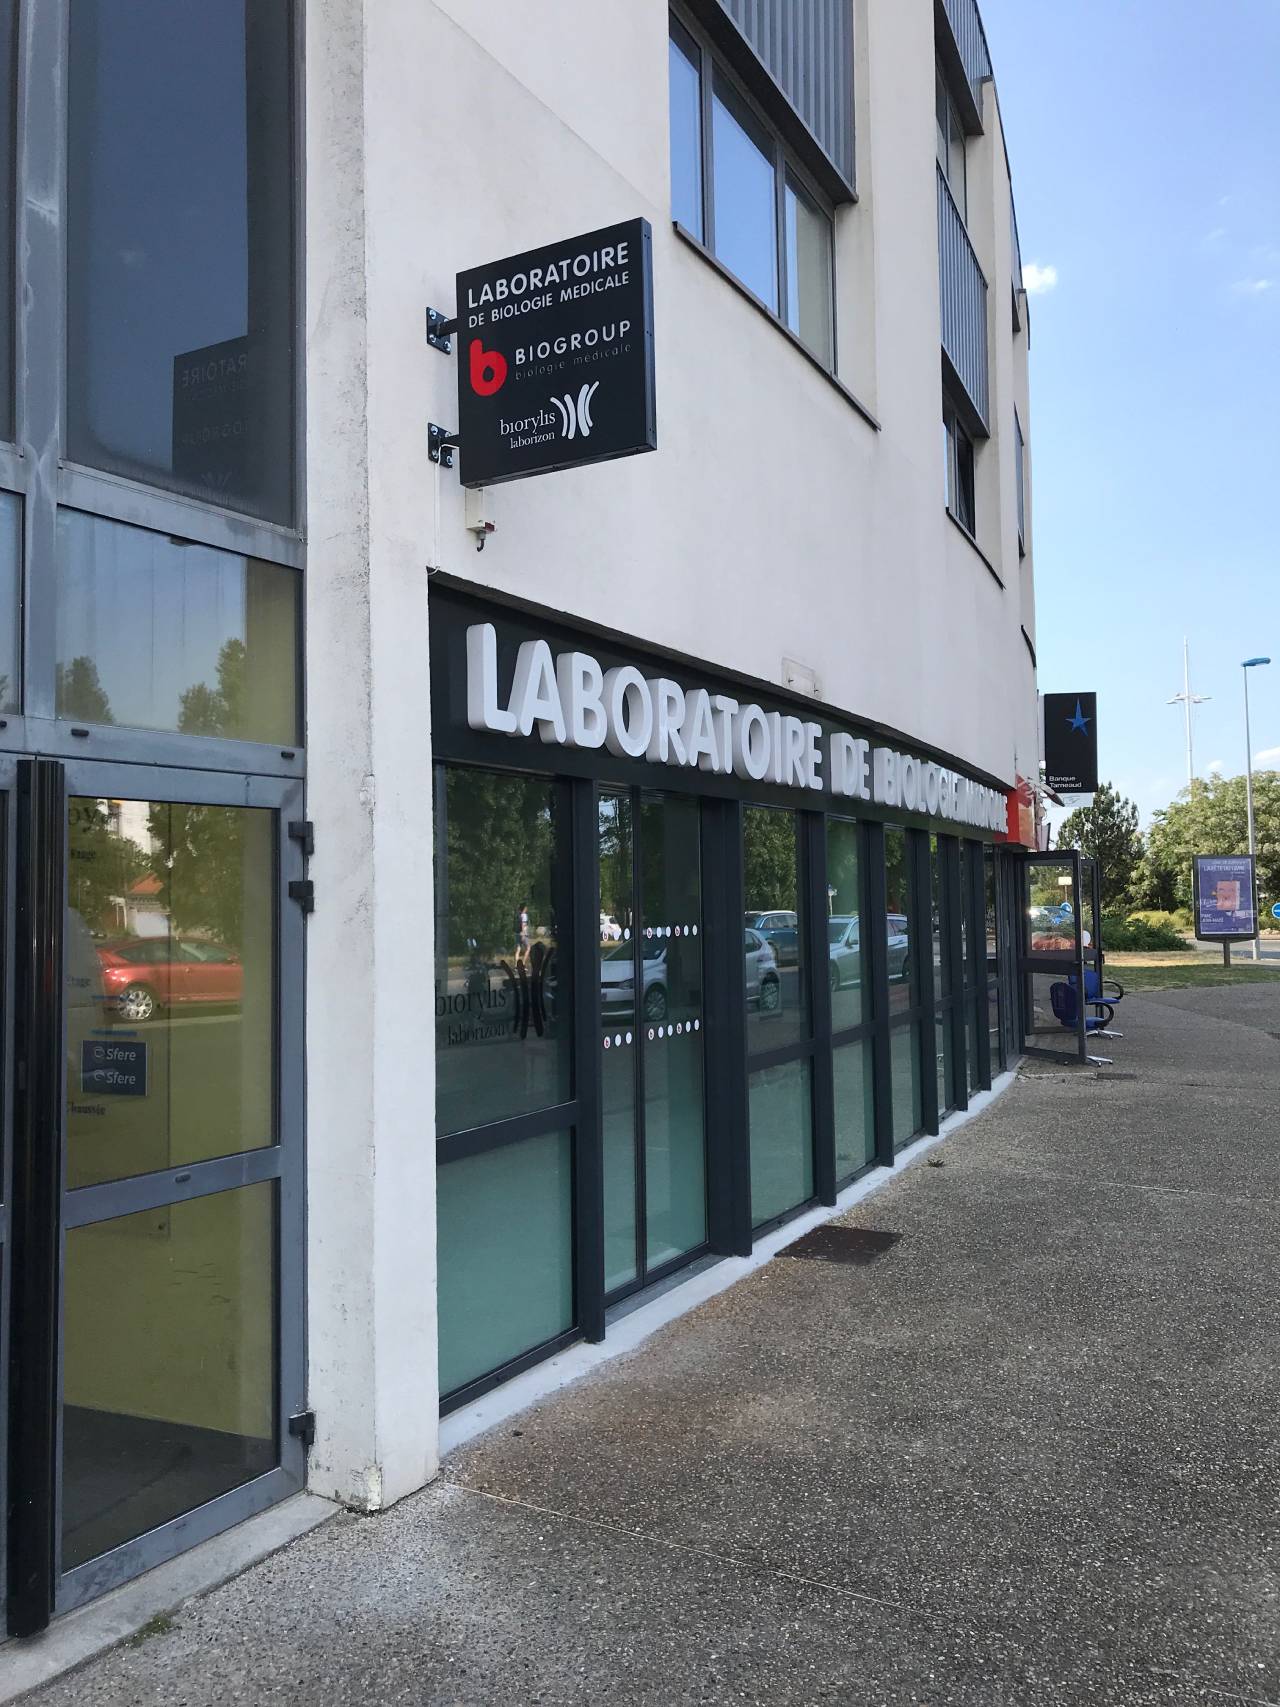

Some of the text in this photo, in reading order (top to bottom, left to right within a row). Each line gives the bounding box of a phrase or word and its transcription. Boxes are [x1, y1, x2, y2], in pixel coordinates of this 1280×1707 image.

[468, 242, 629, 308] LABORATOIRE
[468, 271, 629, 328] DE BIOLOGIE MEDICALE
[515, 320, 631, 365] BIOGROUP
[515, 360, 565, 380] biologie
[499, 409, 556, 435] biorylis
[510, 431, 555, 449] laborizon
[466, 623, 823, 790] LABORATOIRE
[830, 732, 870, 800] DE
[874, 747, 958, 820] BIOLOGIE
[435, 980, 506, 1019] biorylis
[448, 1024, 505, 1046] laborizon
[106, 1047, 136, 1061] Sfere
[106, 1071, 136, 1085] Sfere
